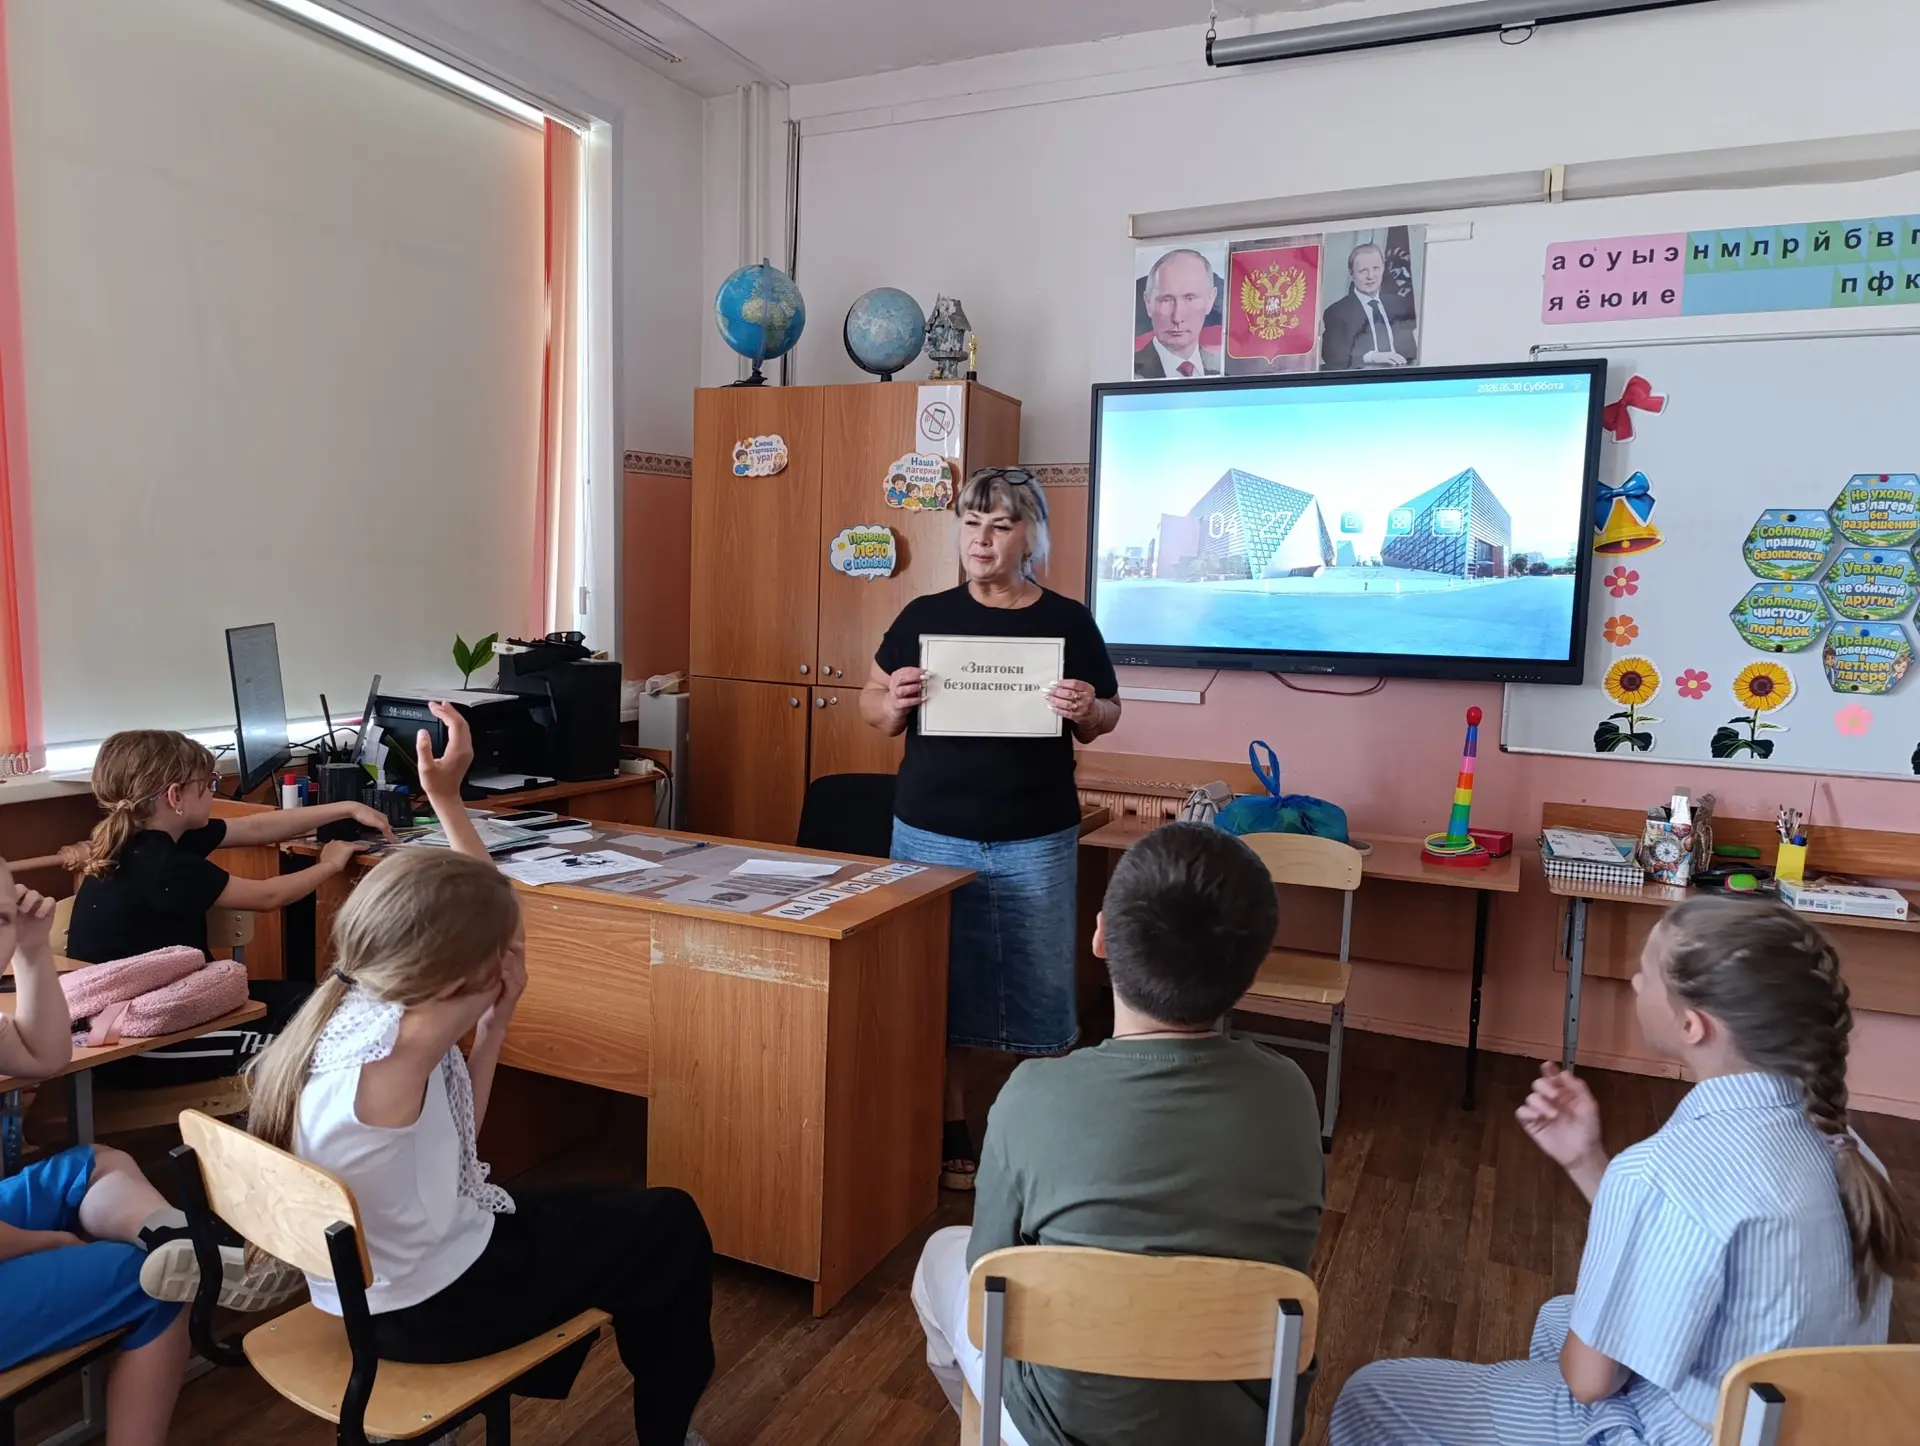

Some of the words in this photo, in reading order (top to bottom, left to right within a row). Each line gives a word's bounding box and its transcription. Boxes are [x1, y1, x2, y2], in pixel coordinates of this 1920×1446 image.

[1551, 255, 1566, 271] а
[1578, 253, 1595, 269] о
[1606, 250, 1622, 272] у
[1632, 248, 1655, 265] ы
[1663, 246, 1679, 262] э
[1693, 244, 1709, 261] н
[1720, 242, 1741, 258] м
[1750, 239, 1770, 257] л
[1781, 237, 1800, 260] р
[1813, 229, 1831, 252] й
[1844, 227, 1862, 250] б
[1876, 231, 1894, 248] в
[1548, 296, 1564, 312] я
[1576, 289, 1591, 310] ё
[1600, 292, 1623, 308] ю
[1632, 290, 1648, 306] и
[1660, 288, 1675, 304] е
[1840, 277, 1858, 294] п
[1867, 270, 1894, 297] ф
[1905, 273, 1920, 290] к
[1523, 381, 1564, 392] Суббота
[757, 453, 773, 464] ура!
[911, 457, 934, 466] Наша
[910, 475, 937, 483] семья!
[1870, 489, 1914, 502] уходи
[1851, 502, 1867, 513] из
[1869, 501, 1915, 513] лагеря
[1870, 511, 1888, 520] без
[1842, 520, 1917, 531] разрешения
[1760, 525, 1824, 539] Соблюдай
[1766, 538, 1816, 549] правила
[854, 544, 888, 558] лето
[1754, 549, 1824, 561] безопасности
[1844, 562, 1904, 578] Уважай
[1837, 584, 1853, 594] не
[1855, 584, 1906, 596] обижай
[1750, 595, 1817, 610] Соблюдай
[1844, 595, 1896, 607] других
[1753, 608, 1811, 623] чистоту
[1749, 624, 1810, 636] порядок
[1835, 634, 1900, 650] Правила
[1835, 646, 1897, 659] поведения
[961, 662, 1024, 674] «Знатоки
[1837, 660, 1890, 671] летнем
[1837, 671, 1887, 683] лагере
[944, 679, 1041, 692] безопасности»
[863, 874, 893, 882] 03
[840, 883, 872, 891] 02
[808, 893, 840, 901] 01
[780, 905, 816, 915] 04
